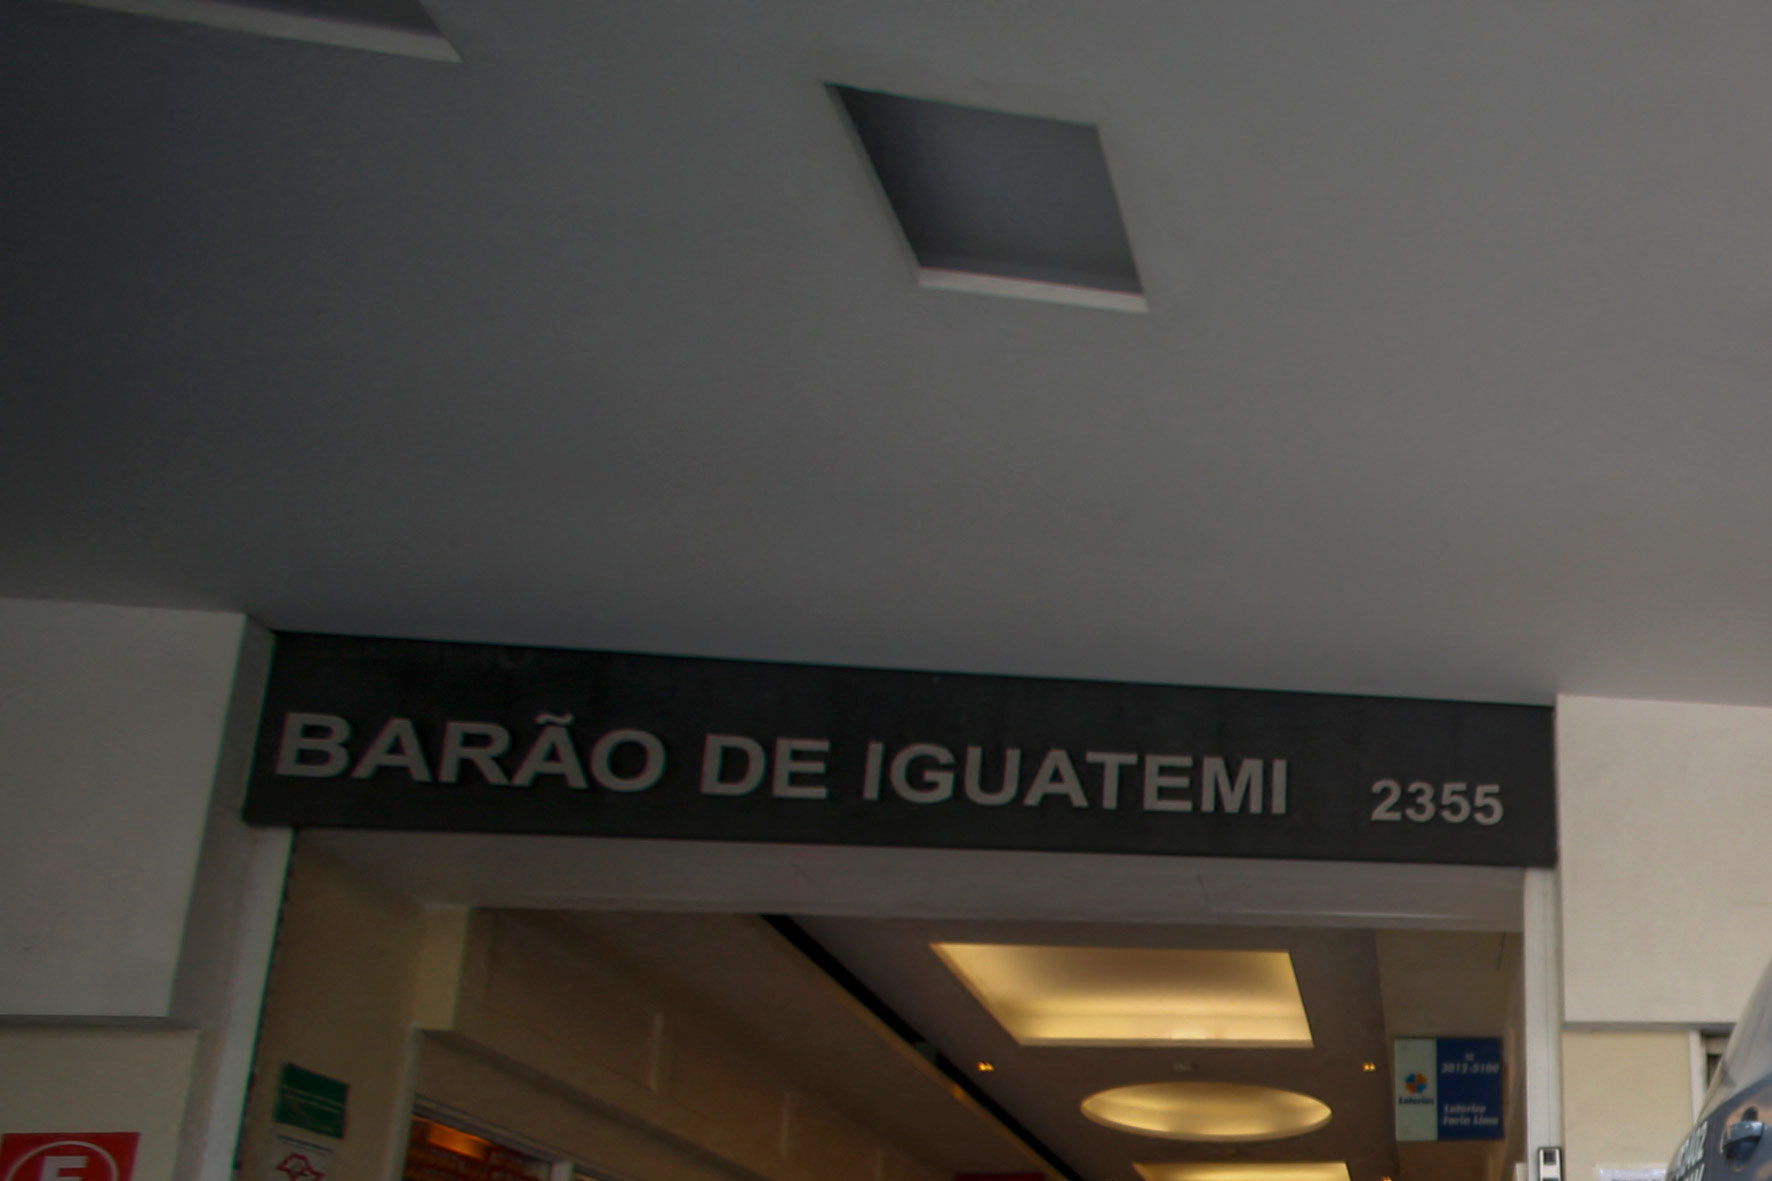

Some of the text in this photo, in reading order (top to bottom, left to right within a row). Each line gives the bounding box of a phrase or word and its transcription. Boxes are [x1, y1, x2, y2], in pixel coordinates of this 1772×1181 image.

[274, 712, 1505, 826] BARÃO DE IGUATEMI 2355
